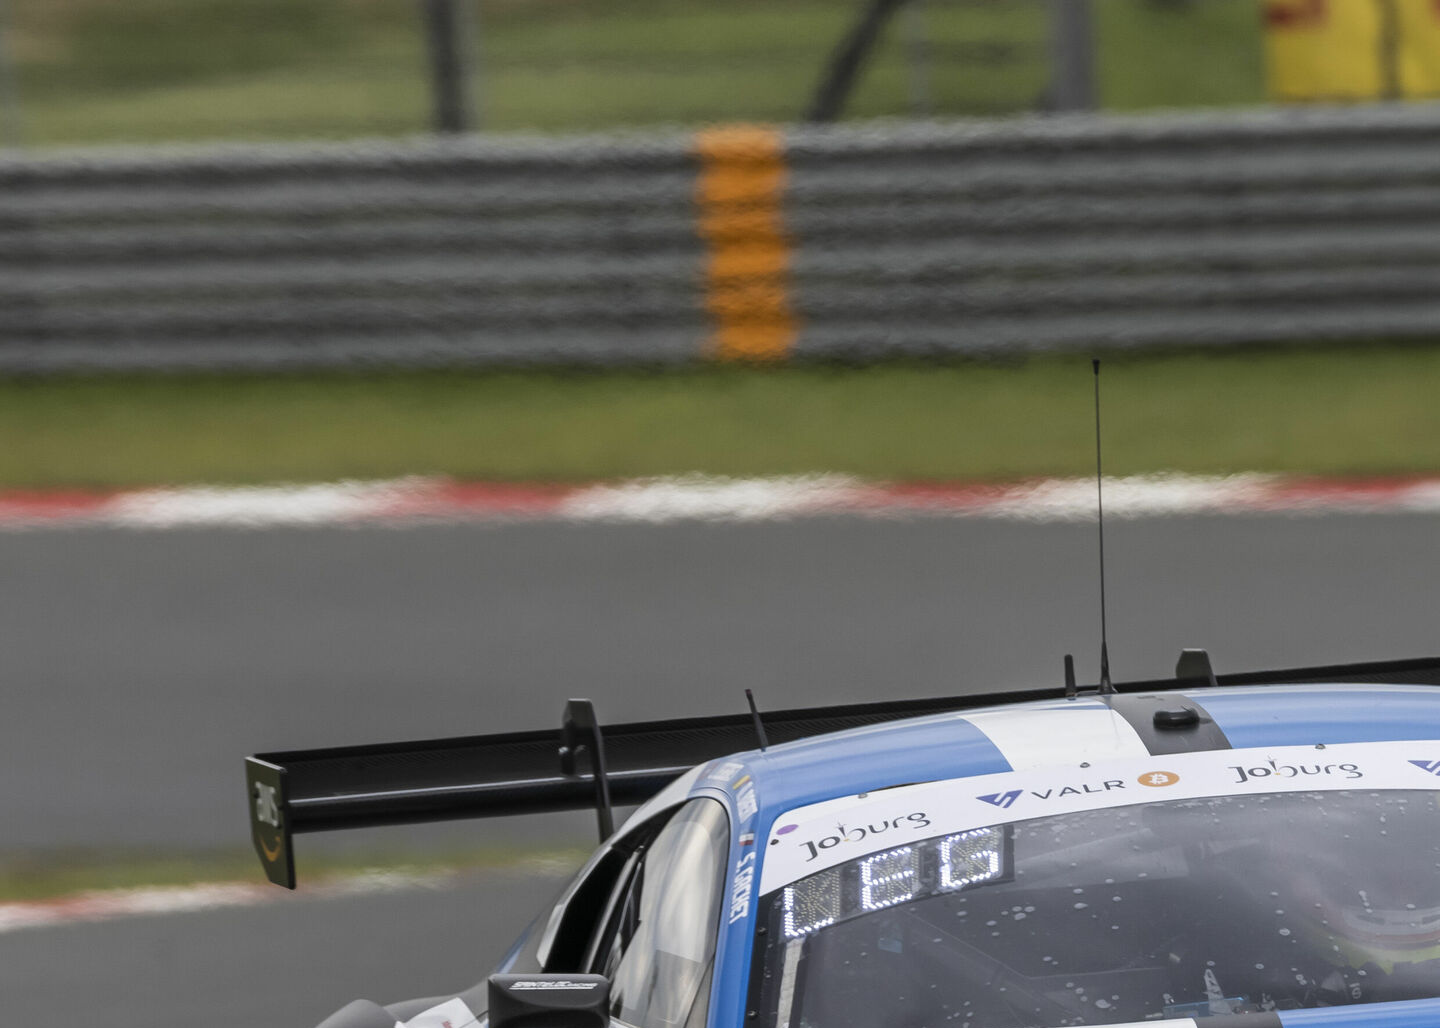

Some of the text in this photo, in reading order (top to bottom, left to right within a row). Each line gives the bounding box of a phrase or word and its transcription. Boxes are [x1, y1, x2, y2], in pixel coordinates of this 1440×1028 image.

[1227, 754, 1364, 784] Joburg
[1031, 779, 1126, 800] VALR
[799, 811, 931, 863] Joburg
